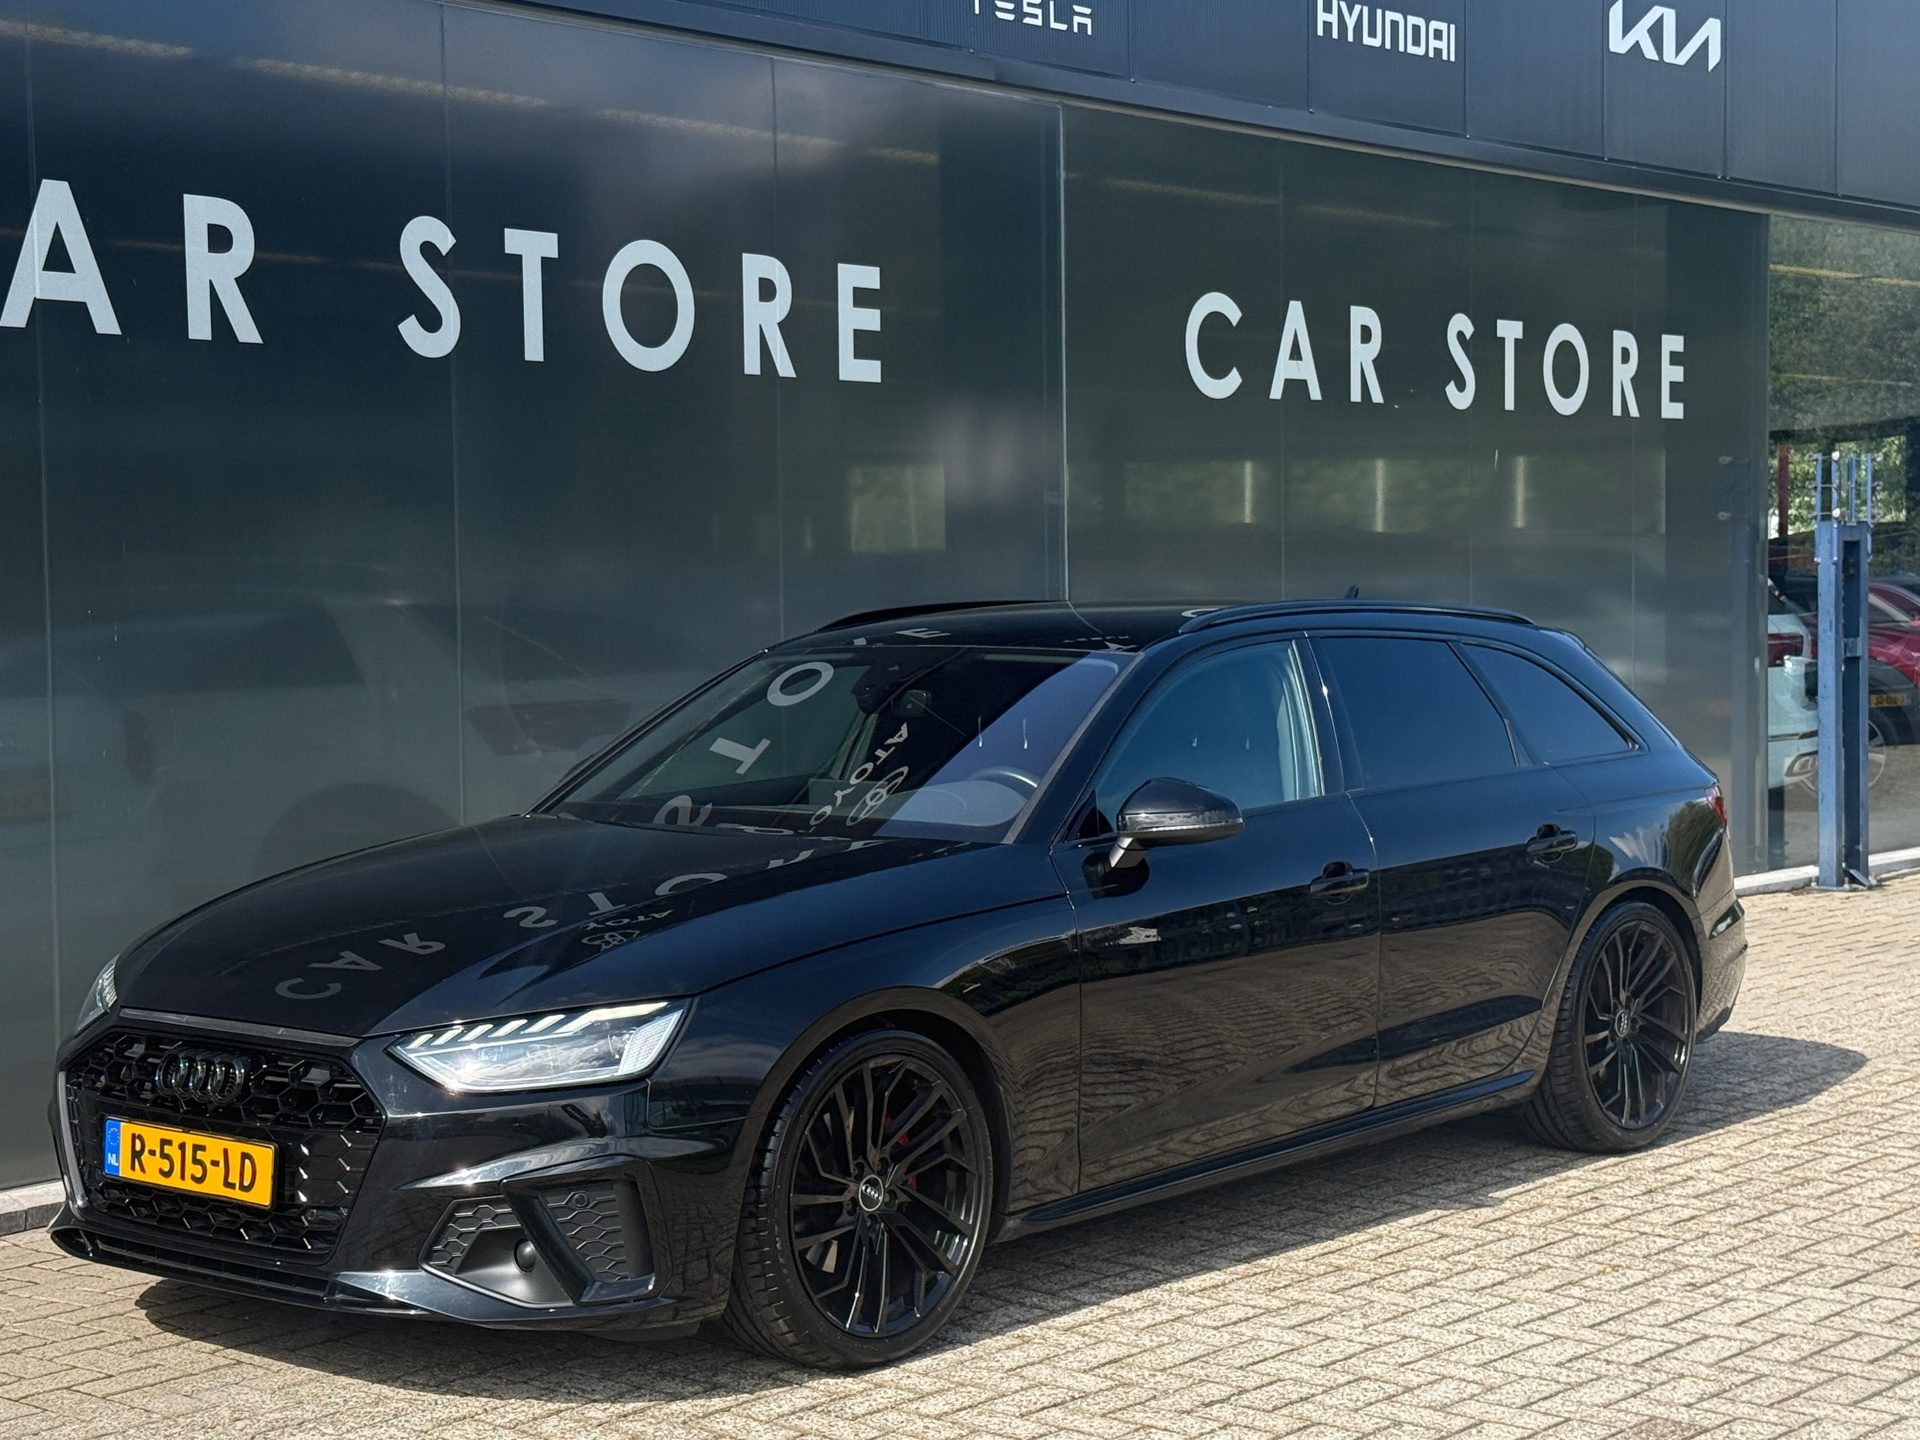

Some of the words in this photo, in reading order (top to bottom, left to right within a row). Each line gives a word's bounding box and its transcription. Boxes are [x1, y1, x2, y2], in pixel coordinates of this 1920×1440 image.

[1317, 0, 1456, 62] HYUNDAI
[1609, 0, 1721, 72] KIA
[0, 179, 263, 344] AR
[398, 215, 882, 383] STORE
[1185, 292, 1384, 403] CAR
[1445, 312, 1685, 420] STORE
[107, 1152, 119, 1166] NL
[130, 1132, 258, 1194] R-515-LD
